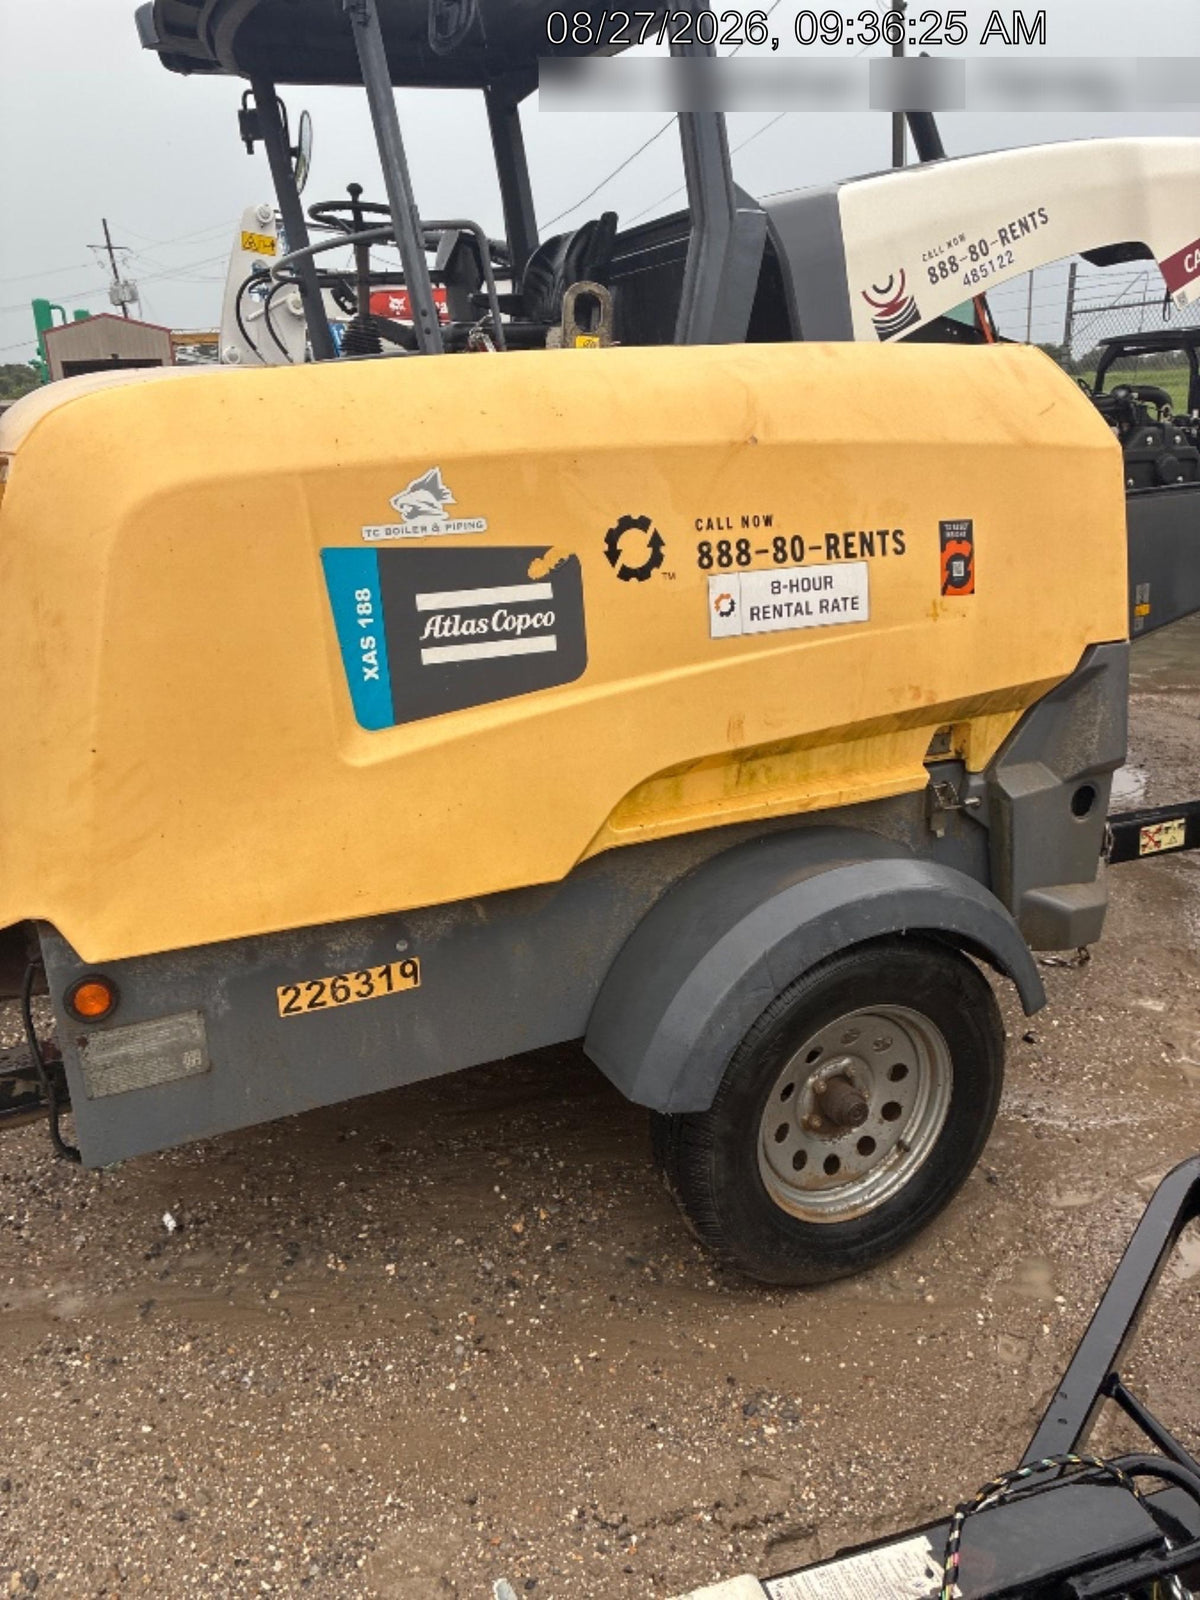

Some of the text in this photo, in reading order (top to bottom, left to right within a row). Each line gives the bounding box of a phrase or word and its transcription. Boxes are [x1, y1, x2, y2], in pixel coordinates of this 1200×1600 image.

[927, 207, 1049, 285] 888-80-RENTS
[963, 250, 1015, 287] 485122
[365, 529, 380, 538] TC
[695, 514, 774, 532] CALL NOW
[696, 529, 907, 569] 888-80-RENTS
[771, 575, 834, 595] 8-HOUR
[419, 609, 556, 641] Atlas Copco
[750, 596, 860, 622] RENTAL RATE
[355, 587, 379, 682] XAS 188
[281, 959, 419, 1014] 226319
